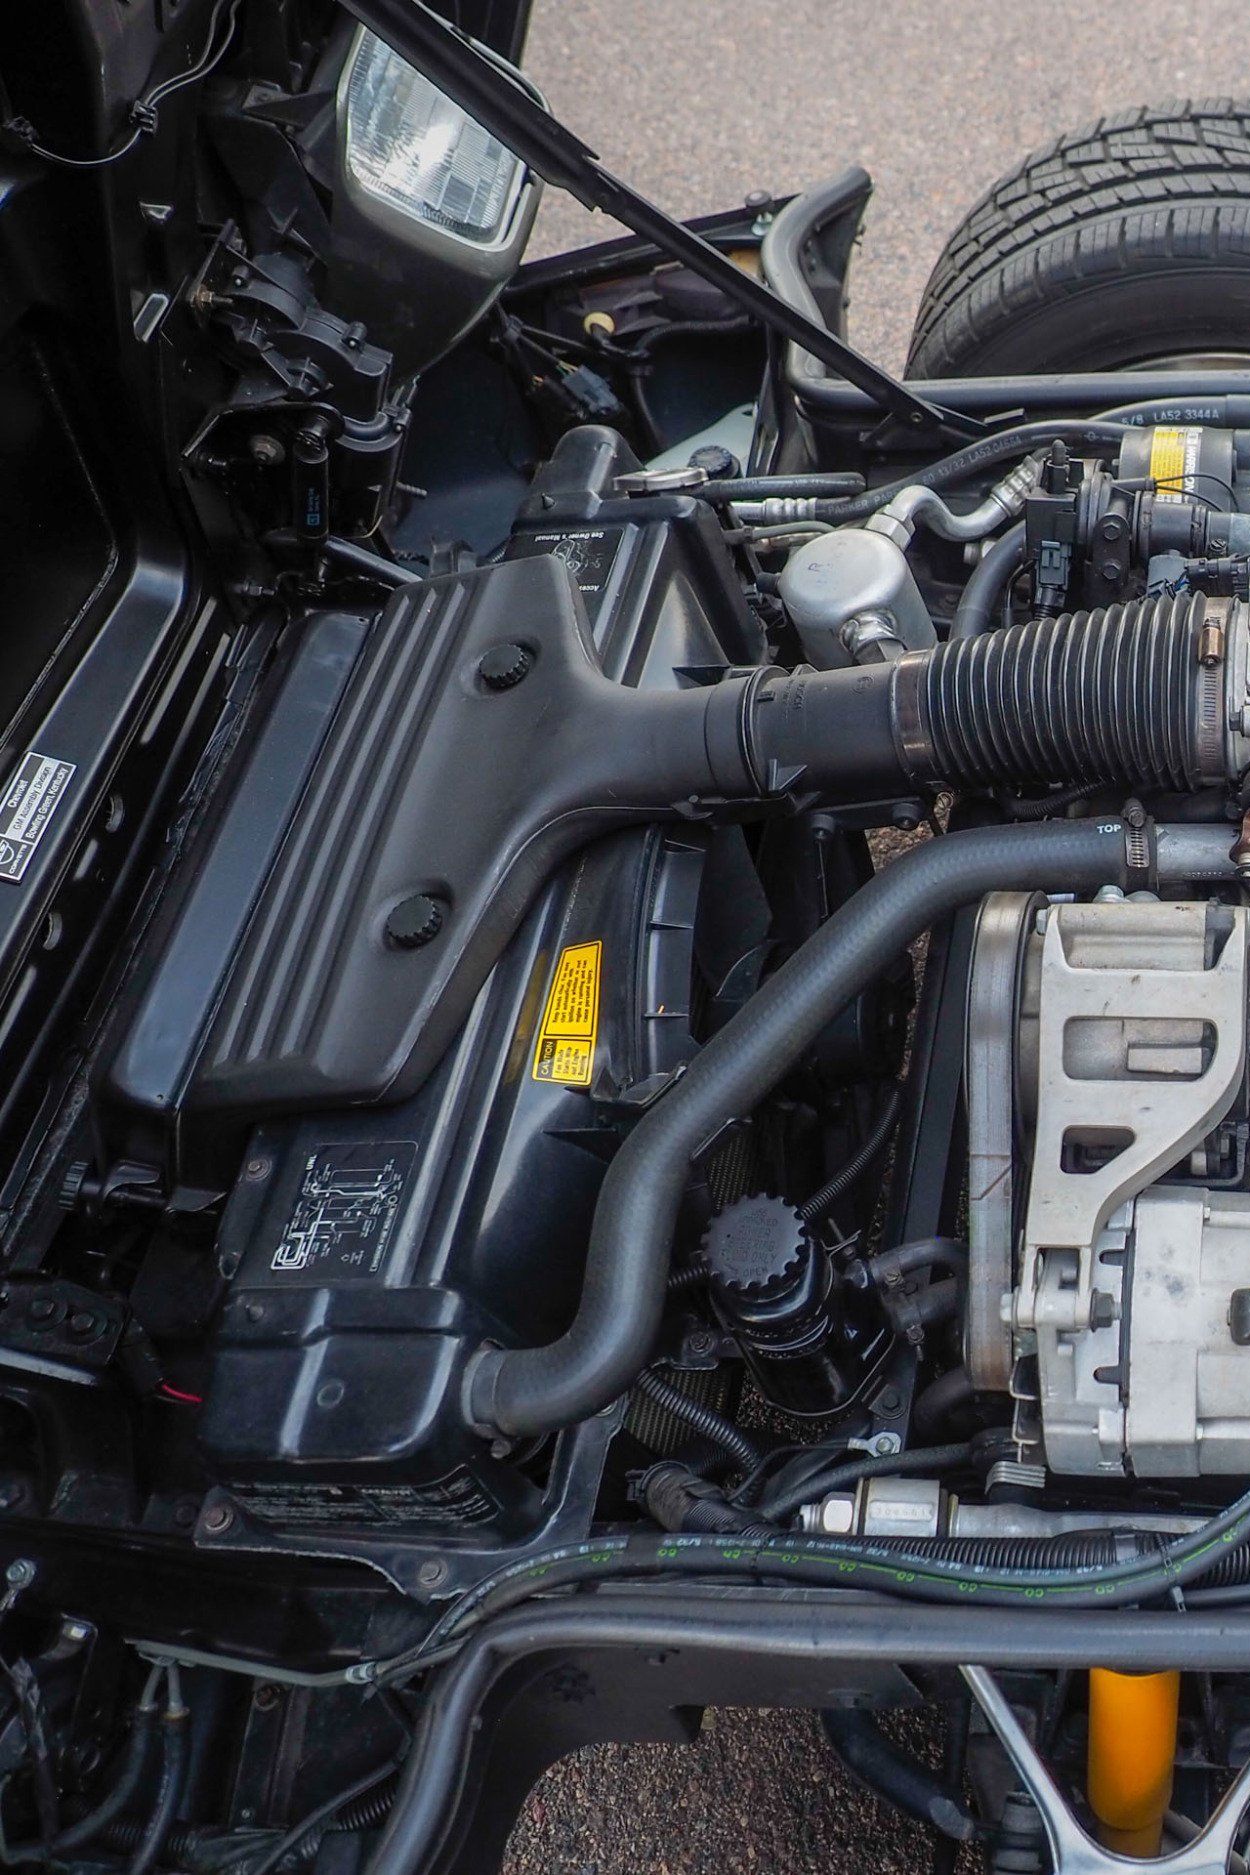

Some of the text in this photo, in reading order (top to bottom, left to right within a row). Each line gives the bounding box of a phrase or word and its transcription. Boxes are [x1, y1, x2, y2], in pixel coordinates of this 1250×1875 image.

[1185, 409, 1219, 420] 3344A
[828, 499, 869, 516] PARKER
[534, 534, 562, 542] Manual
[7, 779, 29, 809] Chevrolet
[12, 766, 51, 831] GM Assembly Division
[25, 813, 46, 839] Bowling
[48, 767, 69, 797] Kentucky
[1097, 824, 1122, 834] TOP
[8, 844, 28, 875] CORVETTE
[564, 979, 572, 1011] automatically
[540, 1041, 554, 1075] CAUTION
